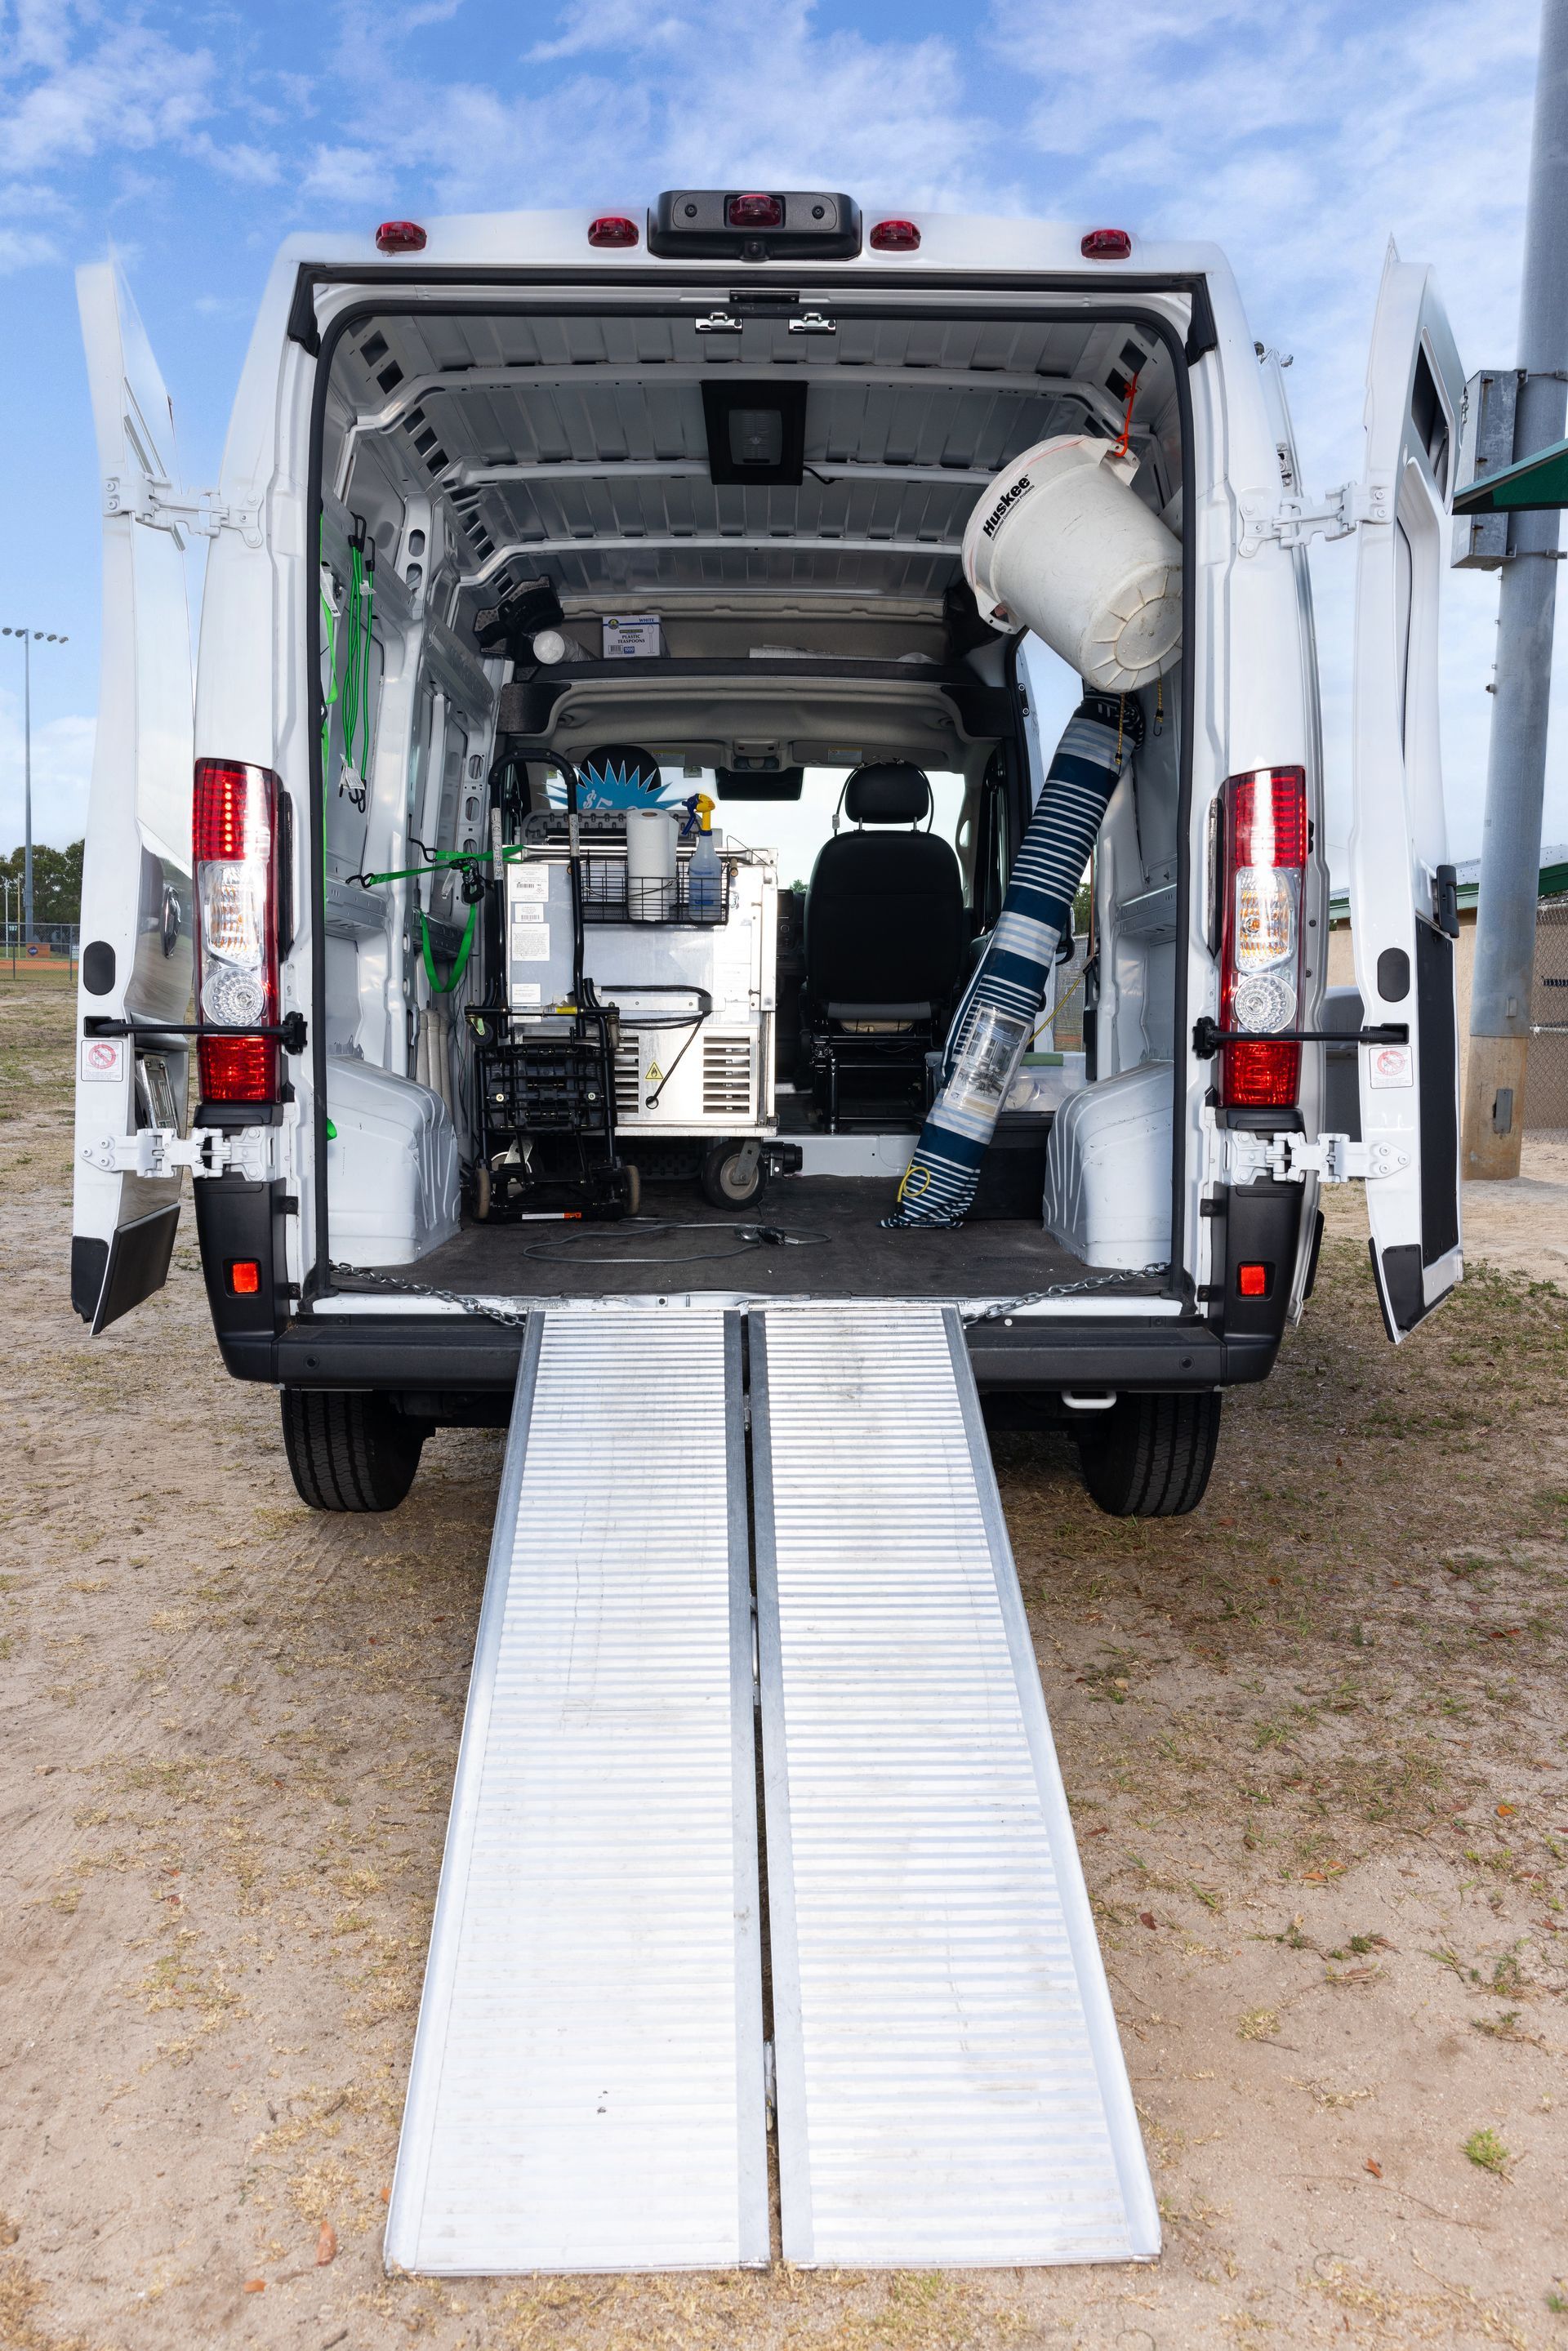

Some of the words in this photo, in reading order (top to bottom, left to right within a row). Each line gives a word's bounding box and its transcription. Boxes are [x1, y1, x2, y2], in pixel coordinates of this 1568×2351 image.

[983, 477, 1030, 537] Huskee
[1003, 498, 1020, 519] Commercial
[1019, 484, 1035, 499] Products
